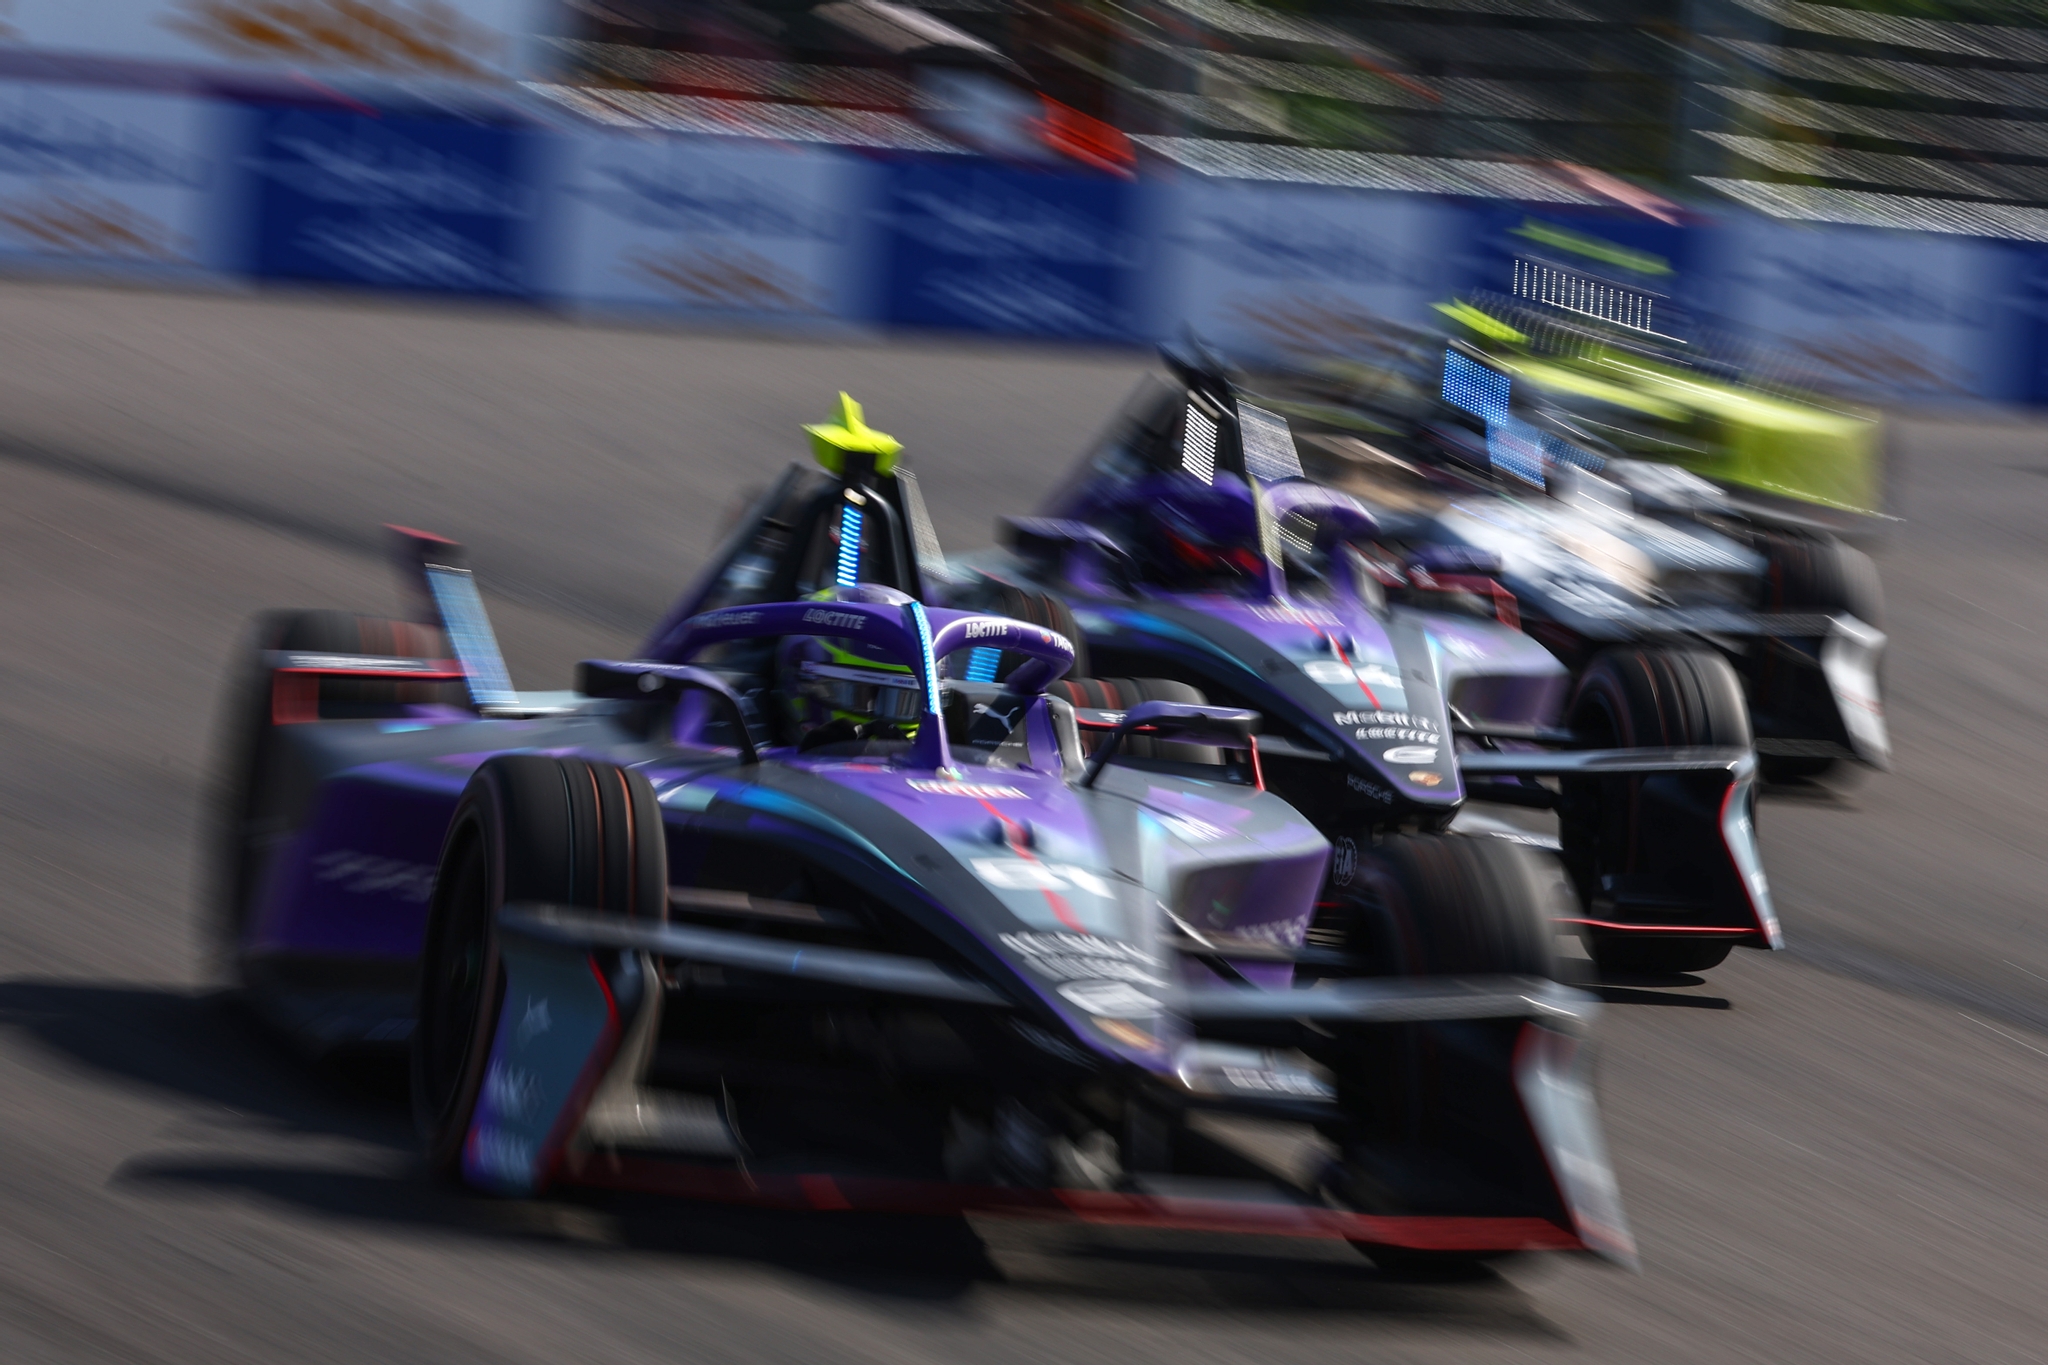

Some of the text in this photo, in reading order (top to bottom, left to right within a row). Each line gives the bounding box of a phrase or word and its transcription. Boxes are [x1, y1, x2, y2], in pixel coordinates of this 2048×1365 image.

[802, 608, 867, 630] LOCTITE
[965, 622, 1008, 639] LOCTITE
[1347, 774, 1393, 804] PORSCHE
